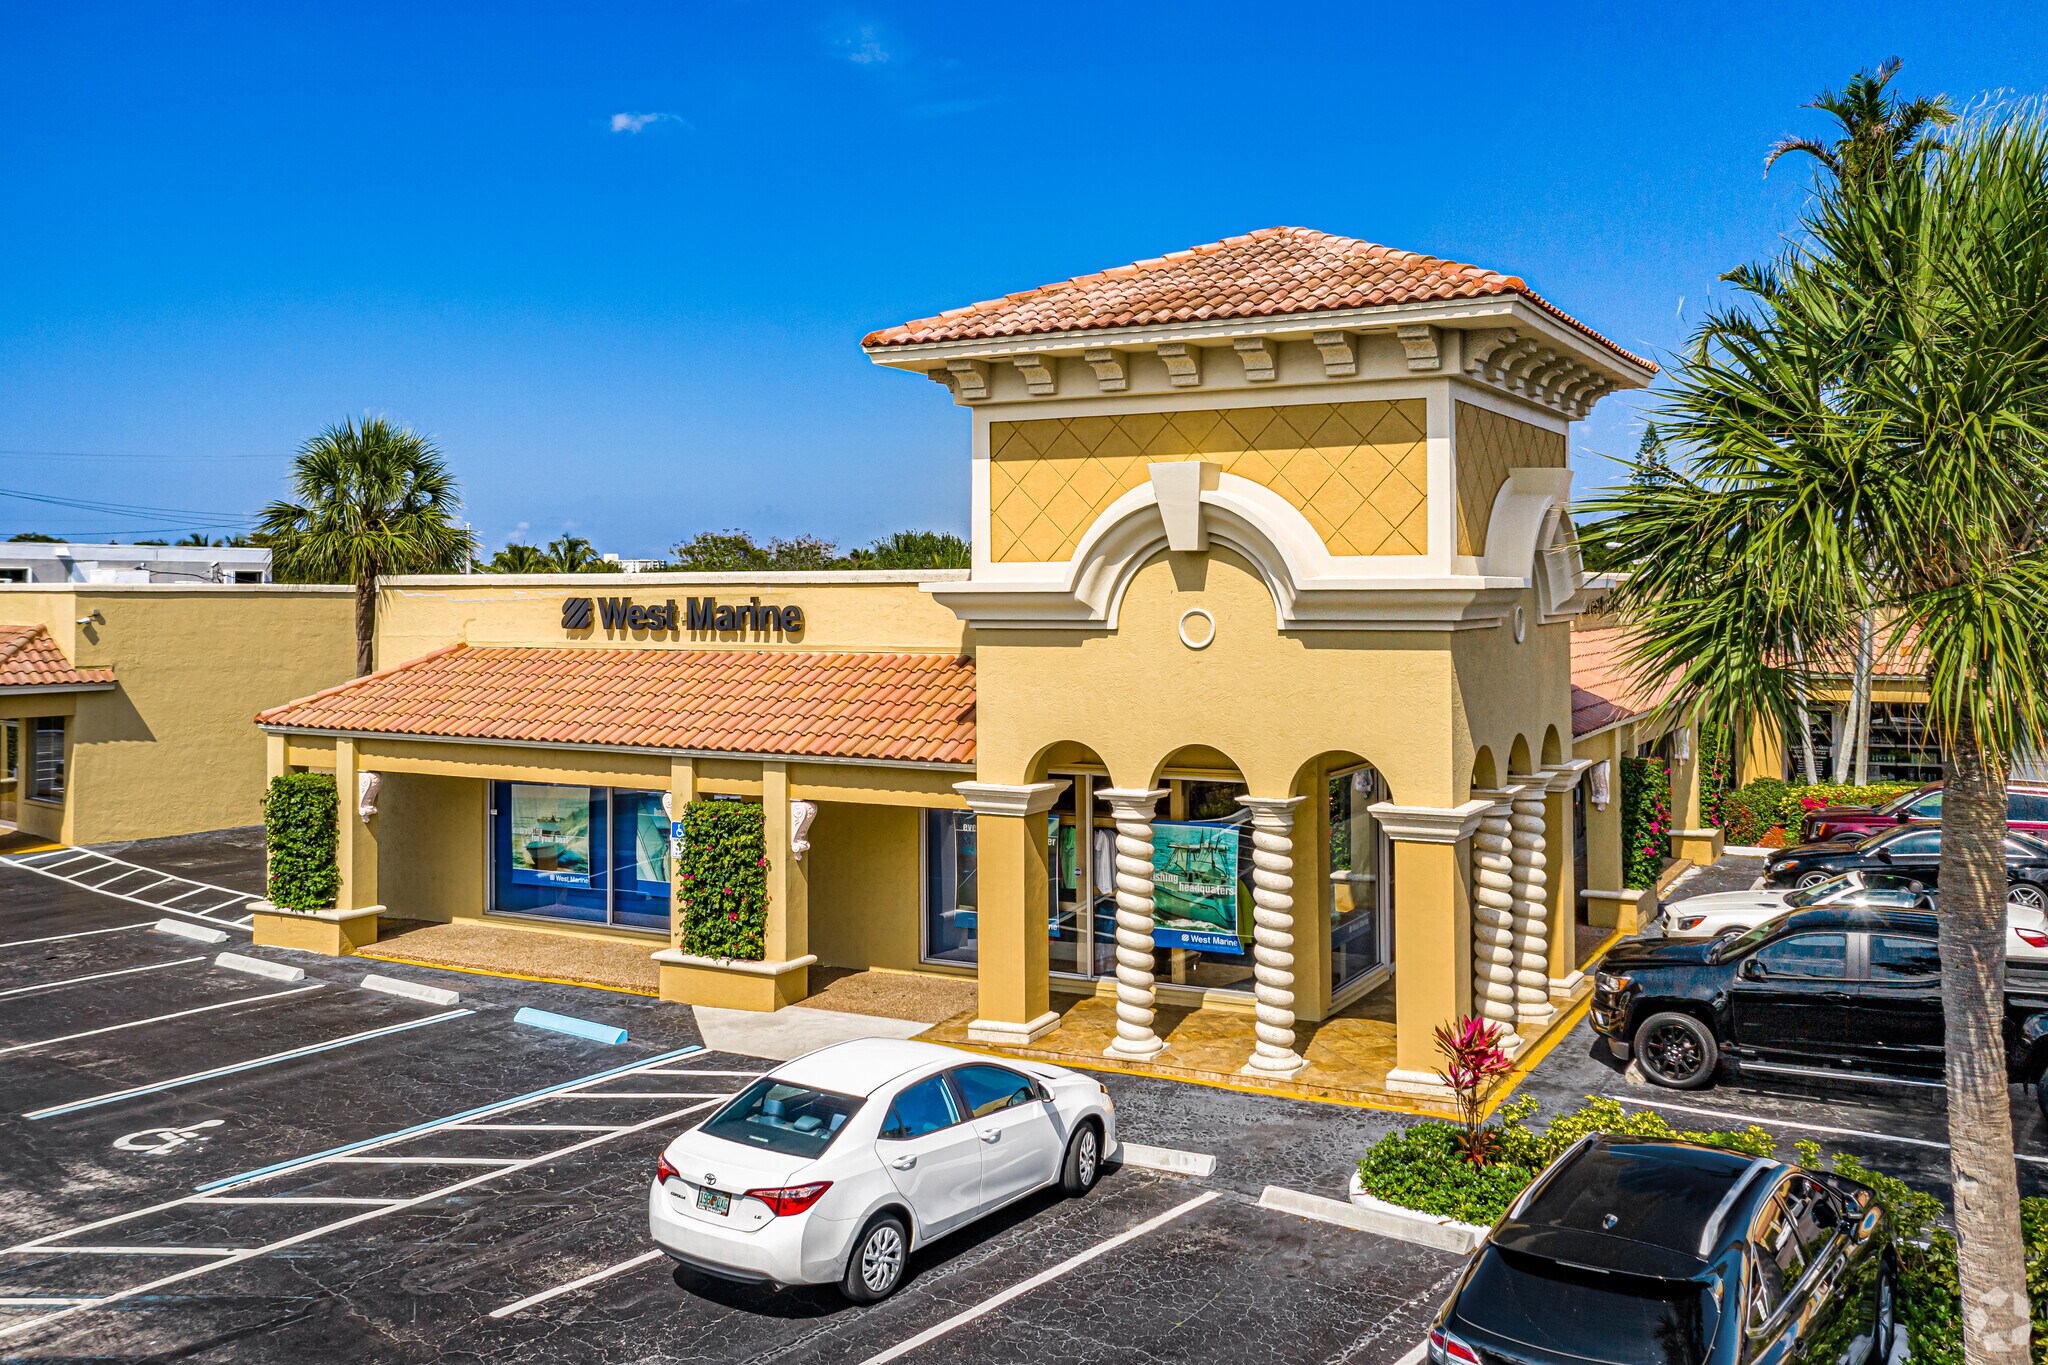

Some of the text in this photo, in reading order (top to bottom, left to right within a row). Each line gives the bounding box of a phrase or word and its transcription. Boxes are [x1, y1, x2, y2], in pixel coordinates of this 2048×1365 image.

[597, 596, 803, 633] West Marine
[556, 874, 589, 884] West Marine
[1190, 934, 1238, 947] West Marine
